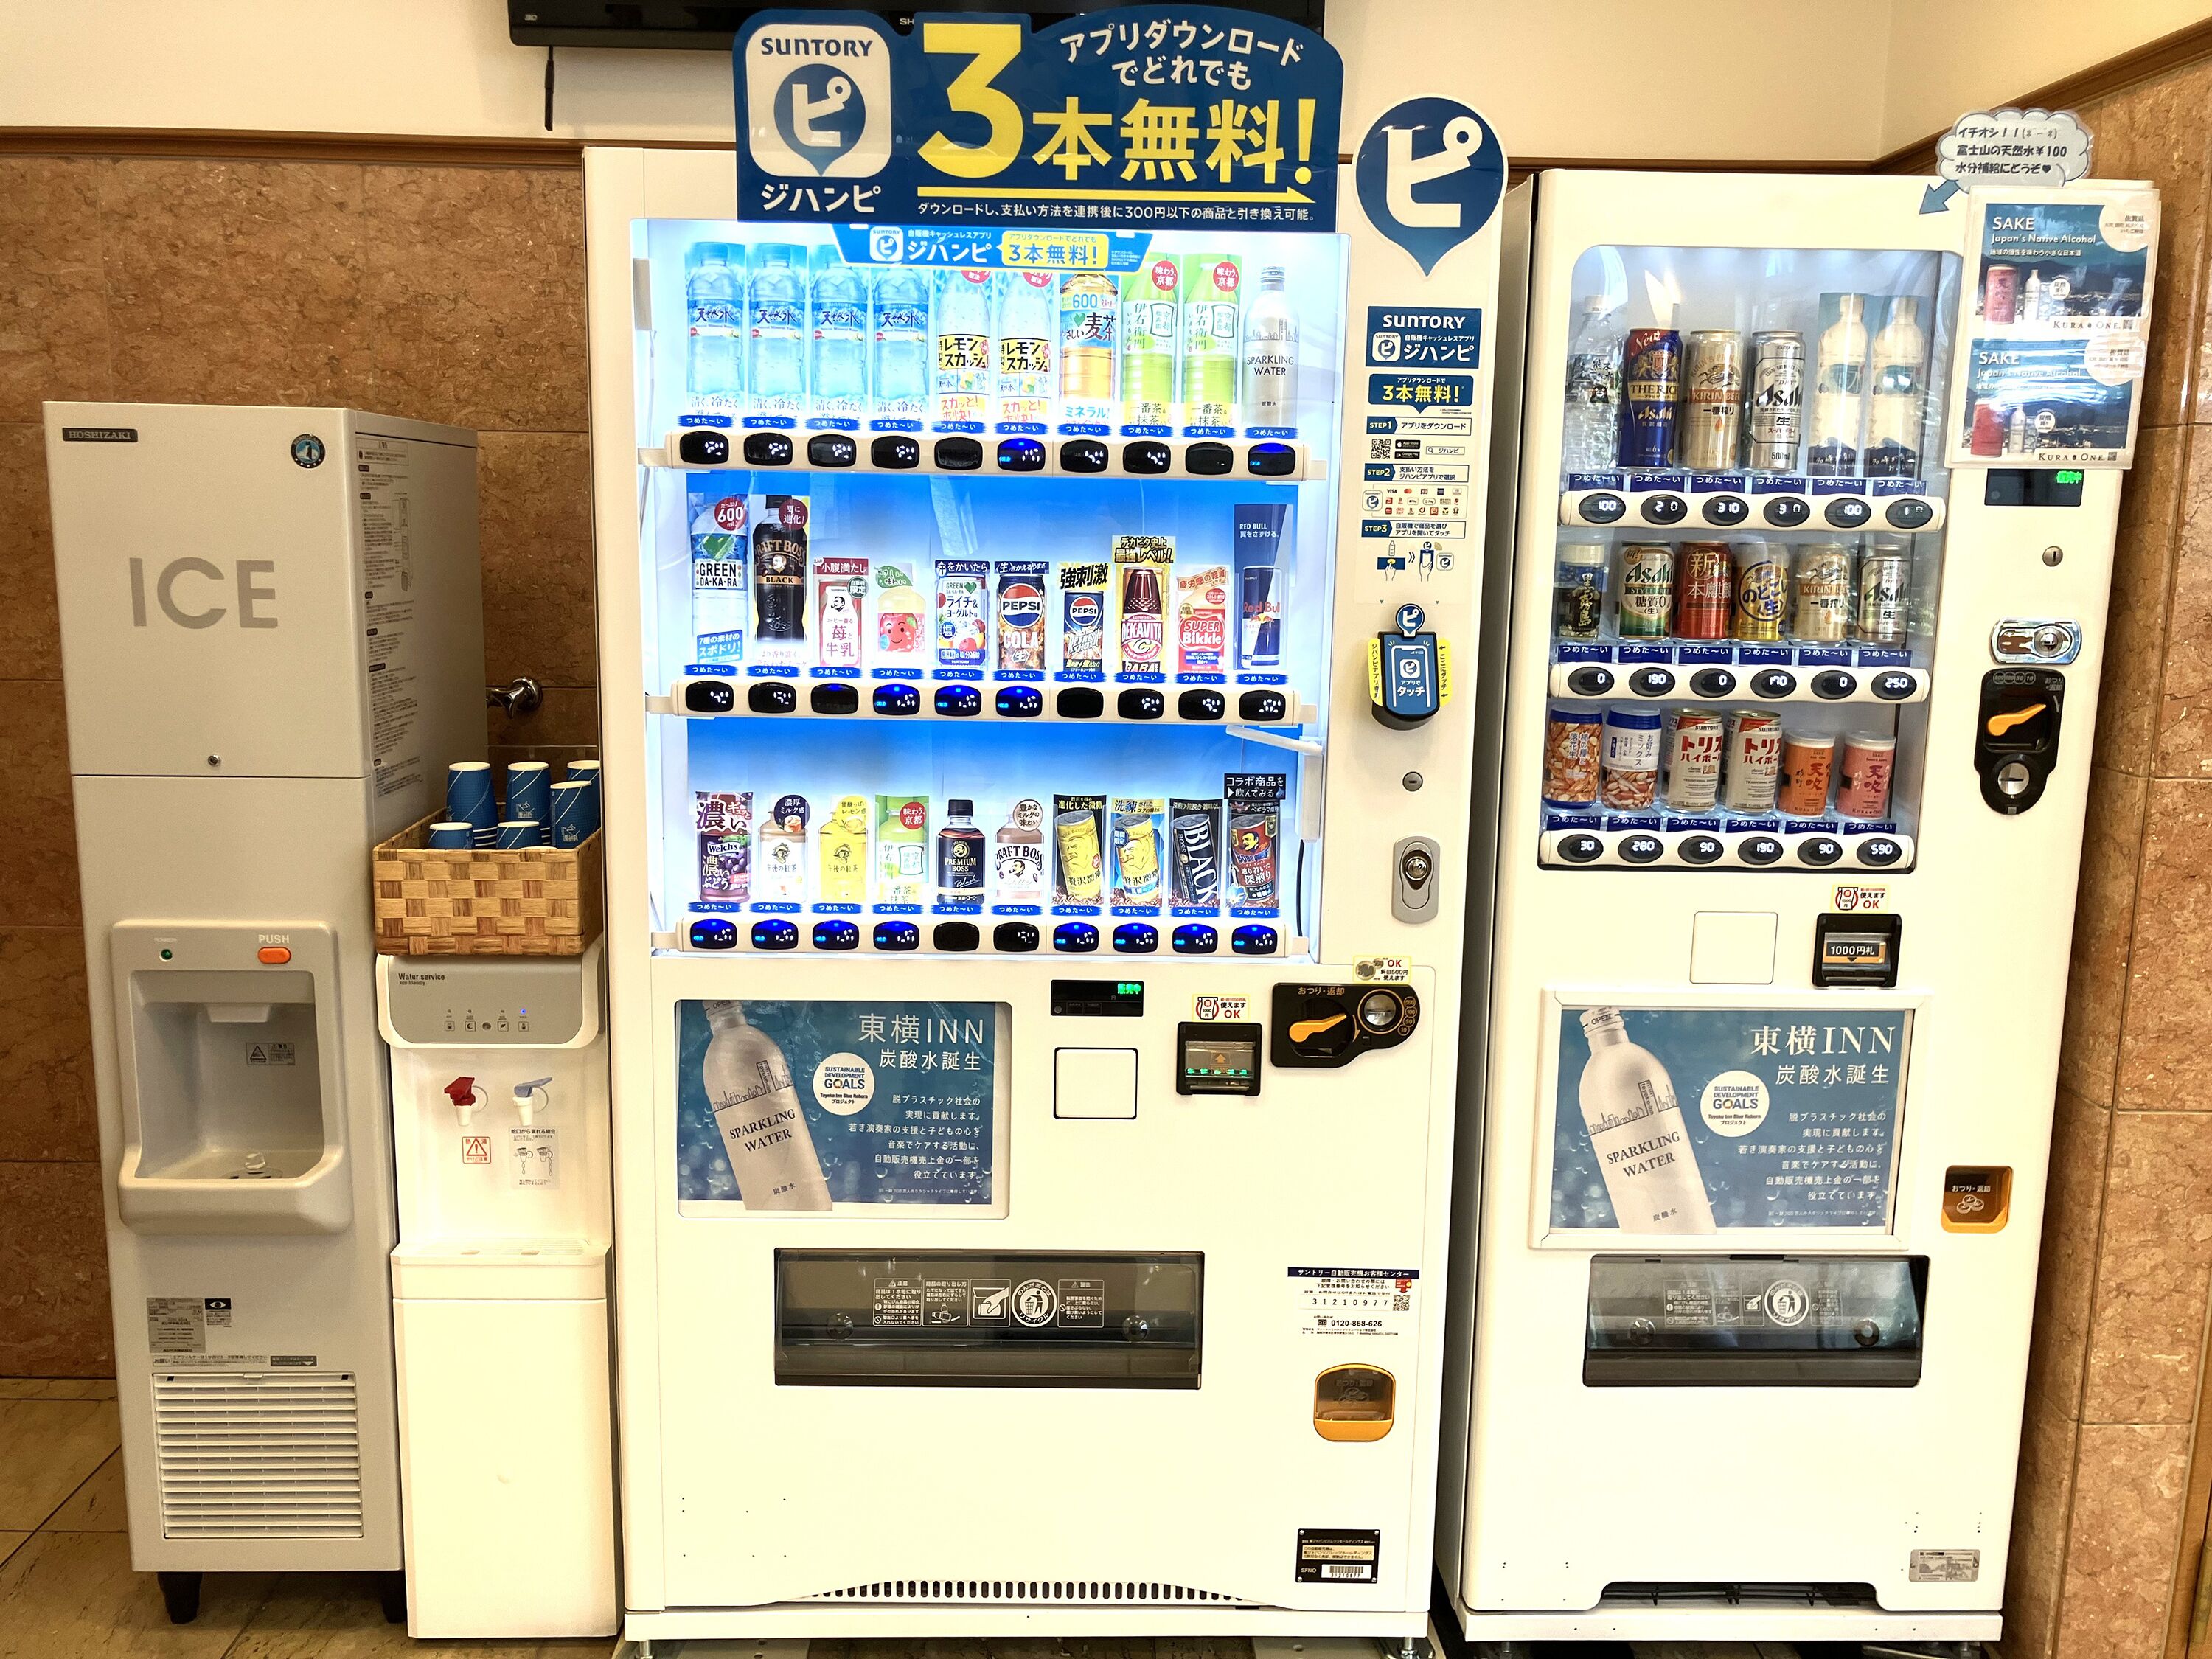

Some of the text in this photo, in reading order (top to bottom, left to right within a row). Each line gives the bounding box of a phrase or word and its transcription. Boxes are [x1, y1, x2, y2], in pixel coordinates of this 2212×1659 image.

[760, 38, 874, 57] SUNTORY
[1060, 18, 1304, 67] アプリダウンロード
[1111, 55, 1251, 91] でどれでも
[791, 75, 852, 147] ピ
[1385, 116, 1483, 228] ピ
[760, 183, 882, 213] ジハンピ
[1992, 217, 2036, 231] SAKE
[908, 229, 992, 240] 自販機キャッシュレスアプリ
[1009, 233, 1097, 244] アプリダウンロードでどれでも
[2060, 234, 2097, 244] Alcohol
[907, 243, 991, 263] ジハンピ
[1155, 275, 1174, 286] 京都
[1217, 276, 1235, 288] 京都
[1073, 294, 1098, 308] 600
[1382, 314, 1466, 329] SUNTORY
[2053, 320, 2084, 330] KURA
[1404, 333, 1475, 343] 自販機キャッシュレスアプリ
[945, 338, 978, 352] レモン
[1006, 342, 1040, 355] レモン
[1403, 344, 1475, 362] ジハンピ
[1978, 351, 2020, 366] SAKE
[945, 353, 987, 368] スカッシュ
[1006, 357, 1049, 372] スカッシュ
[1247, 355, 1294, 366] SPARKLING
[1254, 366, 1287, 376] WATER
[1630, 384, 1654, 394] THE
[1694, 389, 1723, 401] KIRIN
[1638, 405, 1673, 420] Asahi
[1703, 406, 1735, 415] 一番搾り
[1400, 422, 1467, 430] アプリをダウンロード
[1775, 416, 1790, 426] 生
[69, 431, 131, 440] HOSHIZAKI
[2038, 453, 2068, 462] KURA
[717, 507, 744, 523] 600
[1121, 536, 1166, 549] デカビタ史上
[700, 563, 737, 577] GREEN
[821, 563, 867, 574] 小腹満たし
[937, 562, 988, 576] 汗をかいたら
[1624, 562, 1673, 583] Asahi
[765, 576, 794, 584] BLACK
[1060, 563, 1108, 590] 強刺激
[129, 556, 279, 630] ICE
[849, 585, 866, 596] 限定
[1804, 585, 1831, 594] KIRIN
[1002, 601, 1040, 611] PEPSI
[1635, 595, 1666, 608] 糖質0
[1810, 599, 1844, 608] 一番搾り
[1072, 607, 1097, 615] PEPSI
[1882, 611, 1896, 619] 生
[1402, 608, 1420, 627] ピ
[942, 623, 954, 636] 塩
[1184, 620, 1220, 632] SUPER
[1003, 631, 1040, 650] COLA
[1182, 631, 1221, 645] Bikkle
[825, 642, 855, 658] 牛乳
[1397, 686, 1425, 698] タッチ
[1681, 735, 1722, 752] トリス
[1635, 734, 1644, 766] ミックス
[1226, 776, 1283, 787] コラボ商品を
[784, 798, 801, 807] 濃厚
[1057, 800, 1102, 810] 進化した微糖
[1114, 799, 1137, 813] 洗練
[780, 807, 804, 815] ミルク感
[1018, 811, 1040, 819] ミルクの
[904, 815, 922, 825] 京都
[708, 843, 738, 853] Welch's
[702, 855, 730, 877] 濃い
[945, 857, 977, 866] PREMIUM
[1183, 823, 1218, 905] BLACK
[702, 877, 728, 890] ぶどう
[1863, 900, 1880, 909] OK
[259, 934, 290, 945] PUSH
[1830, 945, 1875, 956] 1000円札
[1387, 959, 1402, 967] OK
[398, 973, 445, 981] Water service
[1297, 986, 1346, 995] おつり・返却
[1223, 1009, 1242, 1019] OK
[858, 1013, 984, 1045] 東横INN
[1750, 1024, 1896, 1057] 東横INN
[878, 1049, 981, 1071] 炭酸水誕生
[1775, 1063, 1889, 1087] 炭酸水誕生
[824, 1078, 865, 1091] GOALS
[892, 1095, 980, 1106] 脱プラスチック社会の
[1712, 1098, 1759, 1111] GOALS
[905, 1110, 980, 1121] 実現に貢献します。
[1789, 1111, 1886, 1122] 脱プラスチック社会の
[729, 1108, 796, 1140] SPARKLING
[848, 1123, 980, 1136] 若き演奏家の支援と子どもの心を
[1802, 1128, 1885, 1138] 実現に貢献します。
[744, 1128, 793, 1152] WATER
[888, 1140, 980, 1151] 音楽でケアする活動に、
[1607, 1130, 1681, 1166] SPARKLING
[1738, 1144, 1883, 1155] 若き演奏家の支援と子どもの心を
[874, 1154, 979, 1165] 自動販売機売上金の一部を
[1622, 1152, 1676, 1178] WATER
[1781, 1160, 1882, 1170] 音楽でケアする活動に、
[914, 1169, 979, 1180] 役立てています。
[1765, 1175, 1880, 1186] 自動販売機売上金の一部を
[773, 1182, 796, 1195] 炭酸水
[1807, 1191, 1878, 1201] 役立てています。
[1652, 1208, 1677, 1222] 炭酸水
[1298, 1269, 1410, 1277] サントリー自動販売機お客様センター
[1018, 1281, 1051, 1296] のんだあとは
[1019, 1312, 1049, 1324] リサイクル
[1331, 1319, 1382, 1327] 0120-868-626
